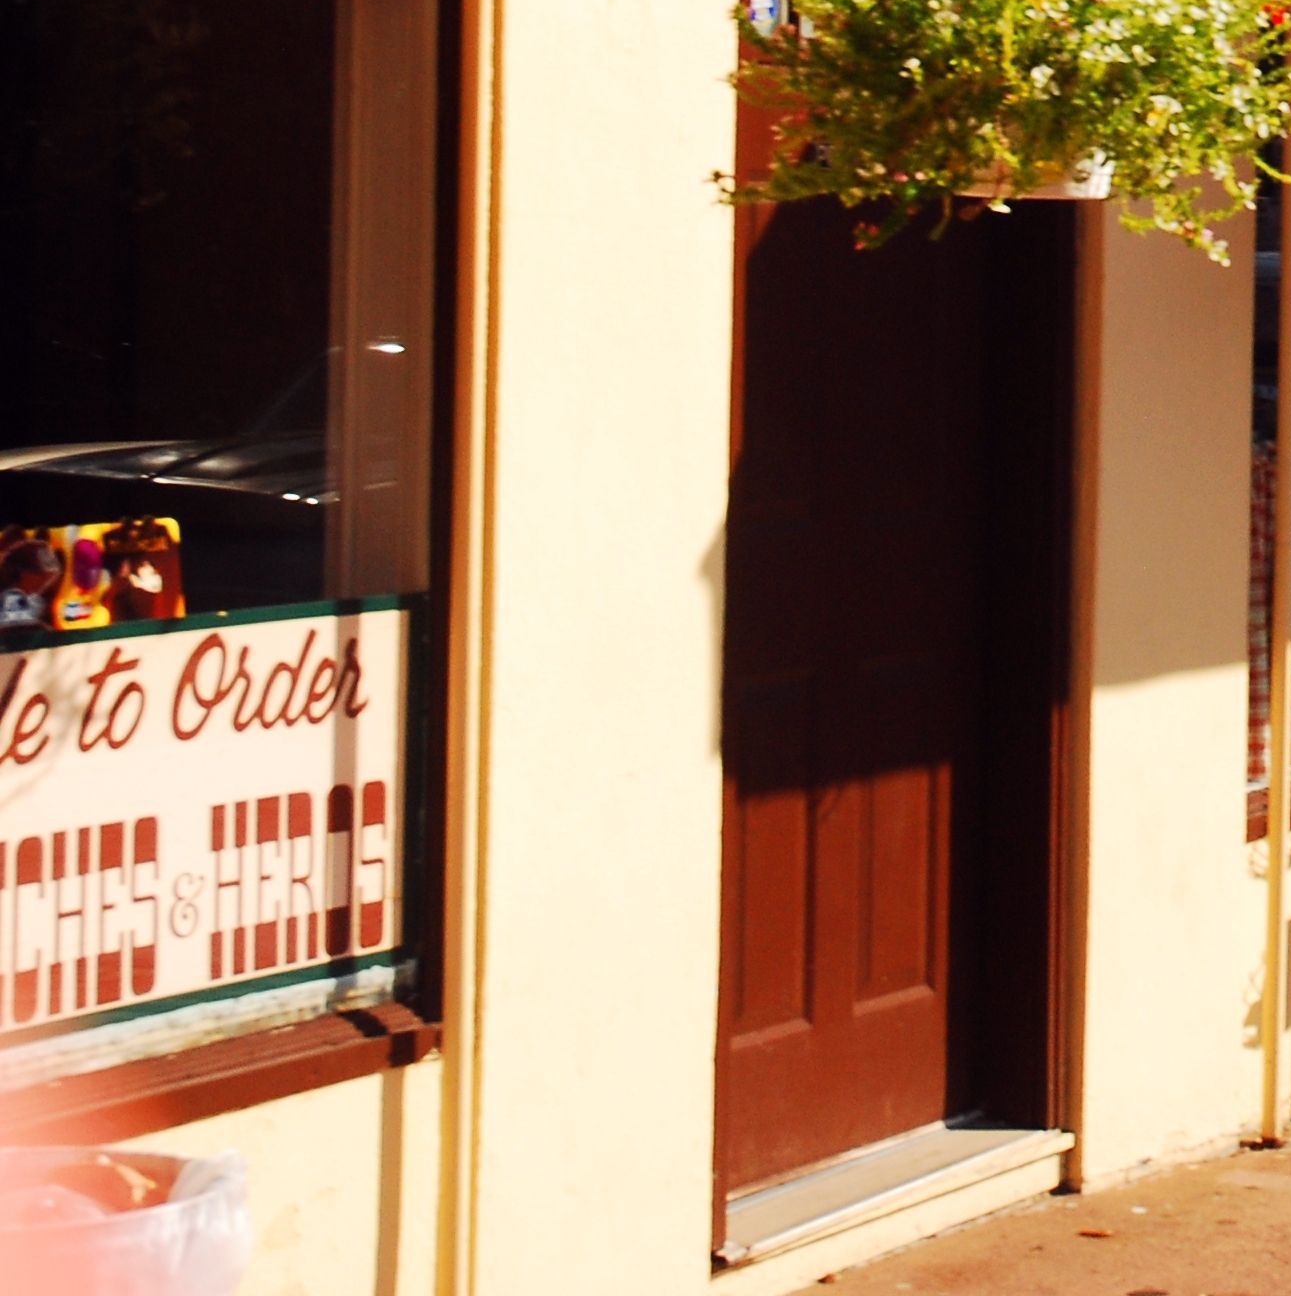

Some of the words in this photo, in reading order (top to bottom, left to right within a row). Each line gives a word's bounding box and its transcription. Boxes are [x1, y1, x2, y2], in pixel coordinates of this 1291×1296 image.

[79, 647, 145, 752] to
[172, 629, 370, 741] Order
[168, 871, 205, 938] &
[209, 780, 385, 981] HEROS
